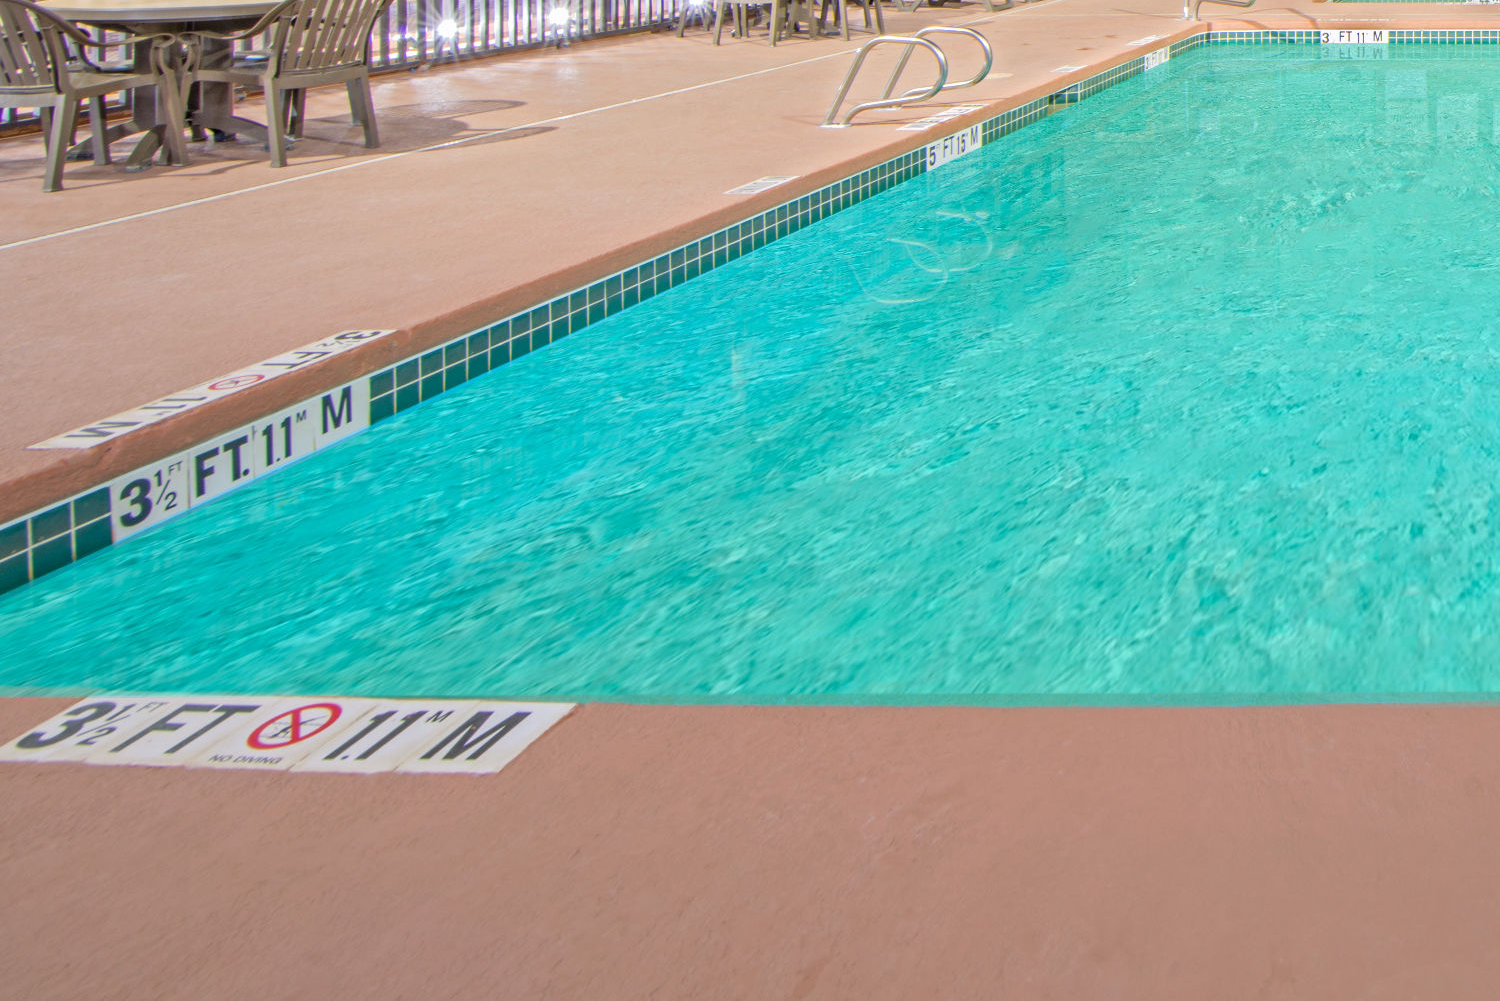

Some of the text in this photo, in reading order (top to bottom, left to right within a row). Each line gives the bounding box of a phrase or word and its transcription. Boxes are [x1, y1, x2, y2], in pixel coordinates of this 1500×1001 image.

[1339, 31, 1352, 42] FT
[1373, 30, 1383, 42] M
[928, 145, 937, 167] 5
[943, 135, 955, 159] FT
[970, 125, 979, 146] M
[321, 385, 352, 435] M
[109, 703, 262, 755] FT
[420, 711, 533, 761] M
